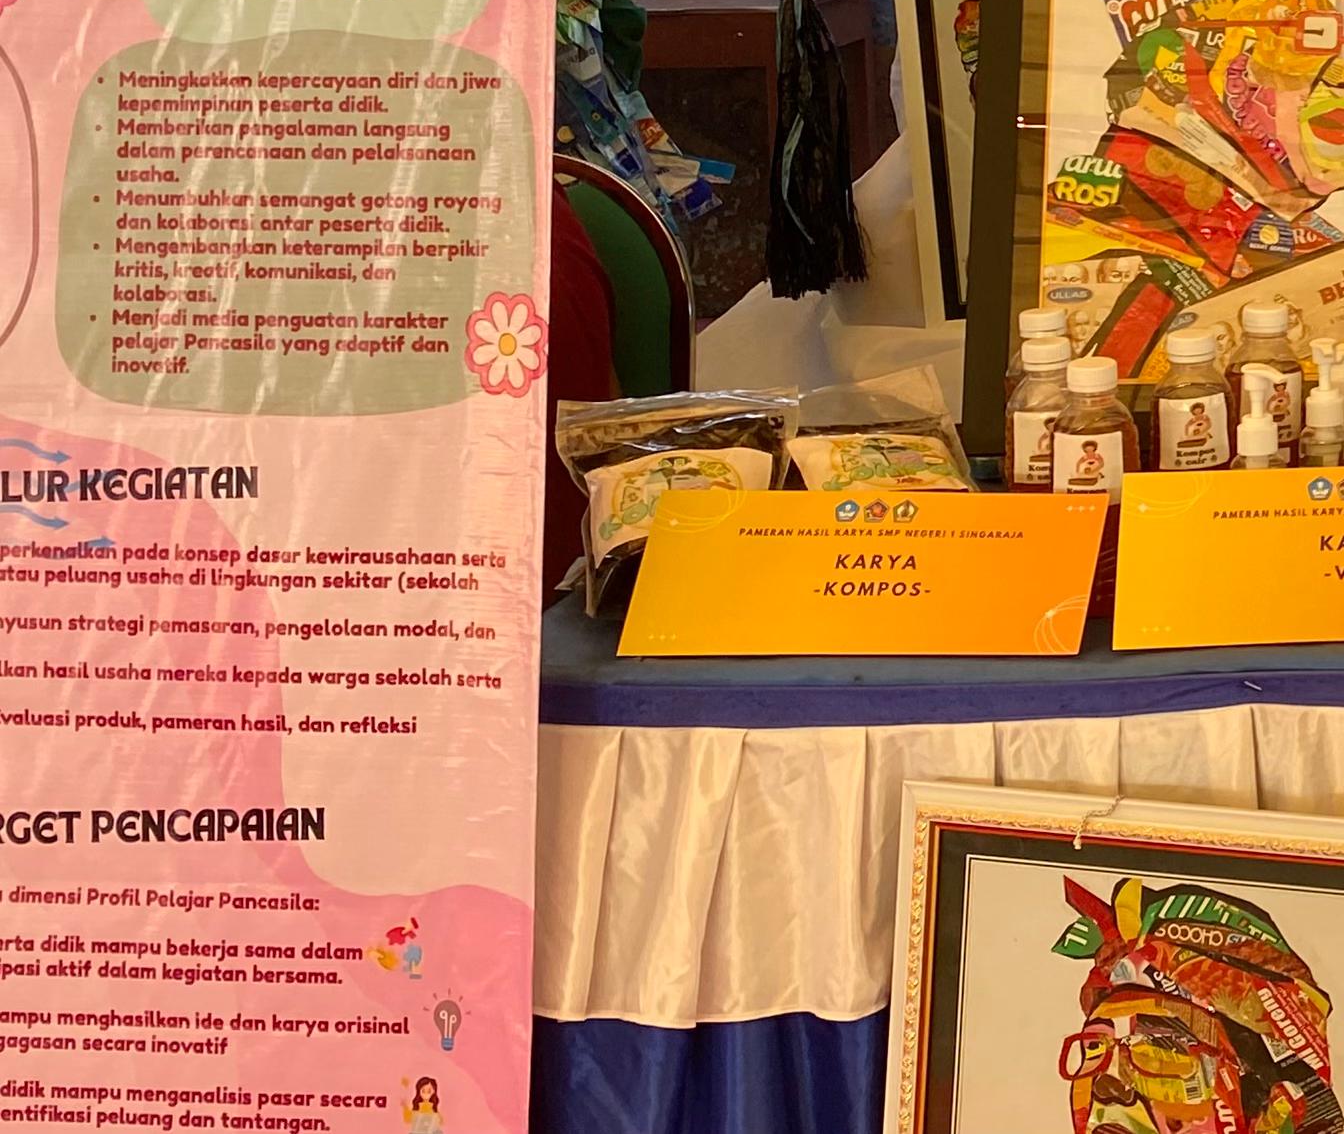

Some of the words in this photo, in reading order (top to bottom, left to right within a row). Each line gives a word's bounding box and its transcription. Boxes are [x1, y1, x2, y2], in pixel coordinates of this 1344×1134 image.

[119, 72, 252, 91] Meningkatkan
[258, 73, 381, 92] kepercayaan
[388, 72, 418, 88] diri
[424, 73, 457, 89] dan
[459, 73, 500, 93] jiwa
[118, 95, 253, 115] kepemimpinan
[259, 97, 332, 115] peserta
[339, 96, 388, 113] didik.
[117, 119, 232, 135] Memberikan
[239, 122, 357, 140] pengalaman
[364, 121, 450, 140] langsung
[1050, 290, 1088, 299] ULLAS
[113, 310, 187, 329] Menjadi
[193, 311, 248, 329] media
[255, 312, 357, 331] penguatan
[363, 312, 448, 329] karakter
[80, 466, 258, 501] KEGIATAN
[1213, 510, 1269, 519] PAMERAN
[1274, 509, 1307, 517] HASIL
[739, 529, 793, 537] PAMERAN
[798, 529, 829, 537] HASIL
[835, 529, 872, 537] KARYA
[878, 529, 900, 537] SMP
[906, 529, 945, 538] NEGERI
[960, 531, 1024, 539] SINGARAJA
[1, 542, 116, 560] perkenalkan
[123, 543, 169, 563] pada
[175, 544, 240, 566] konsep
[247, 547, 300, 566] dasar
[306, 547, 456, 566] kewirausahaan
[462, 550, 505, 568] serta
[835, 554, 916, 570] KARYA
[0, 710, 70, 727] valuasi
[75, 710, 146, 731] produk,
[152, 717, 236, 733] pameran
[241, 715, 292, 734] hasil,
[299, 716, 335, 734] dan
[340, 716, 416, 735] refleksi
[91, 807, 325, 843] PENCAPAIAN
[9, 887, 81, 905] dimensi
[87, 888, 140, 907] Profil
[147, 890, 213, 912] Pelajar
[219, 892, 319, 911] Pancasila:
